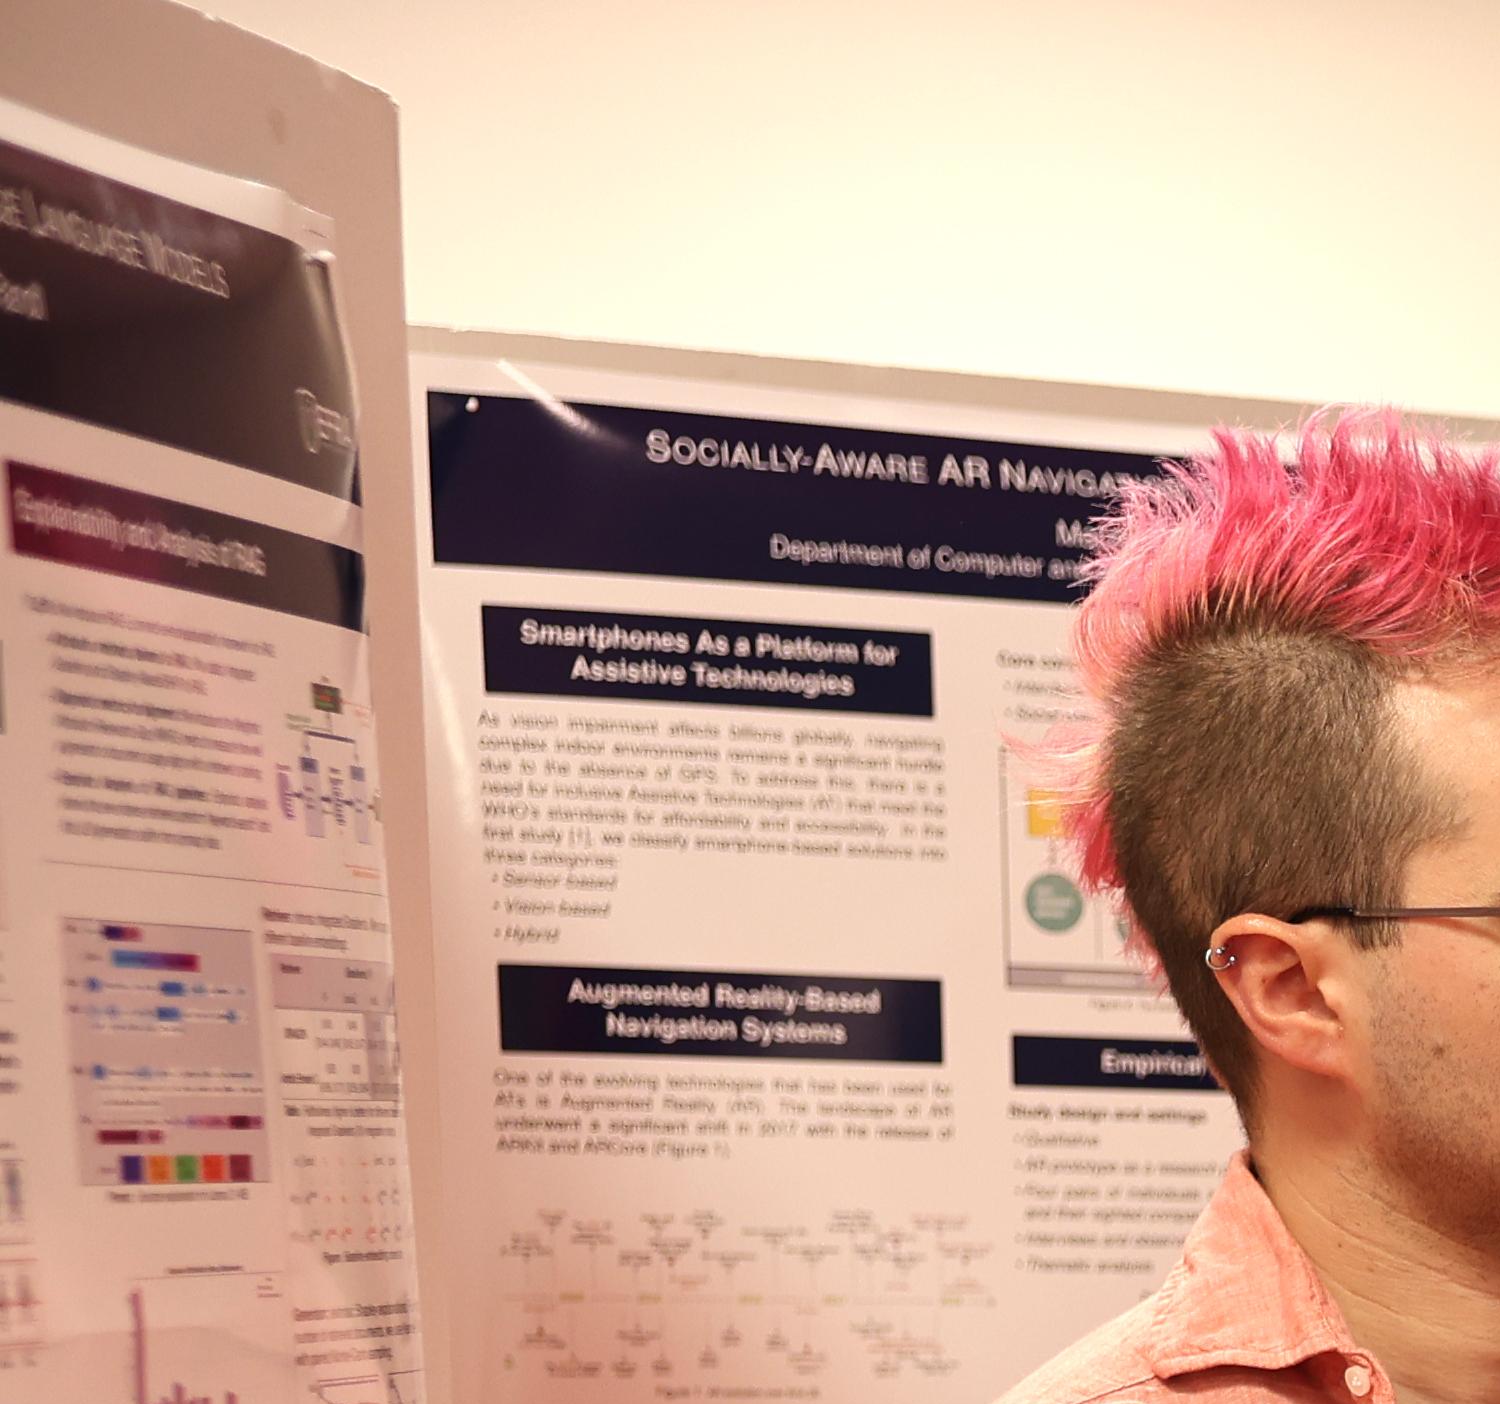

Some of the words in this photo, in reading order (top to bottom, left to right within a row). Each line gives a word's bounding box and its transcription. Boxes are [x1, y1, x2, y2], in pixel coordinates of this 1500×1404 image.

[938, 453, 992, 489] AR
[769, 532, 904, 570] Department
[907, 544, 931, 569] of
[935, 546, 1043, 579] Computer
[519, 618, 690, 654] Smartphones
[696, 630, 730, 657] As
[734, 637, 752, 658] a
[756, 633, 859, 664] Platform
[863, 641, 898, 667] for
[570, 655, 687, 686] Assistive
[693, 661, 856, 699] Technologies
[567, 978, 710, 1009] Augmented
[715, 982, 883, 1017] Reality-Based
[605, 1011, 738, 1044] Navigation
[741, 1015, 848, 1048] Systems
